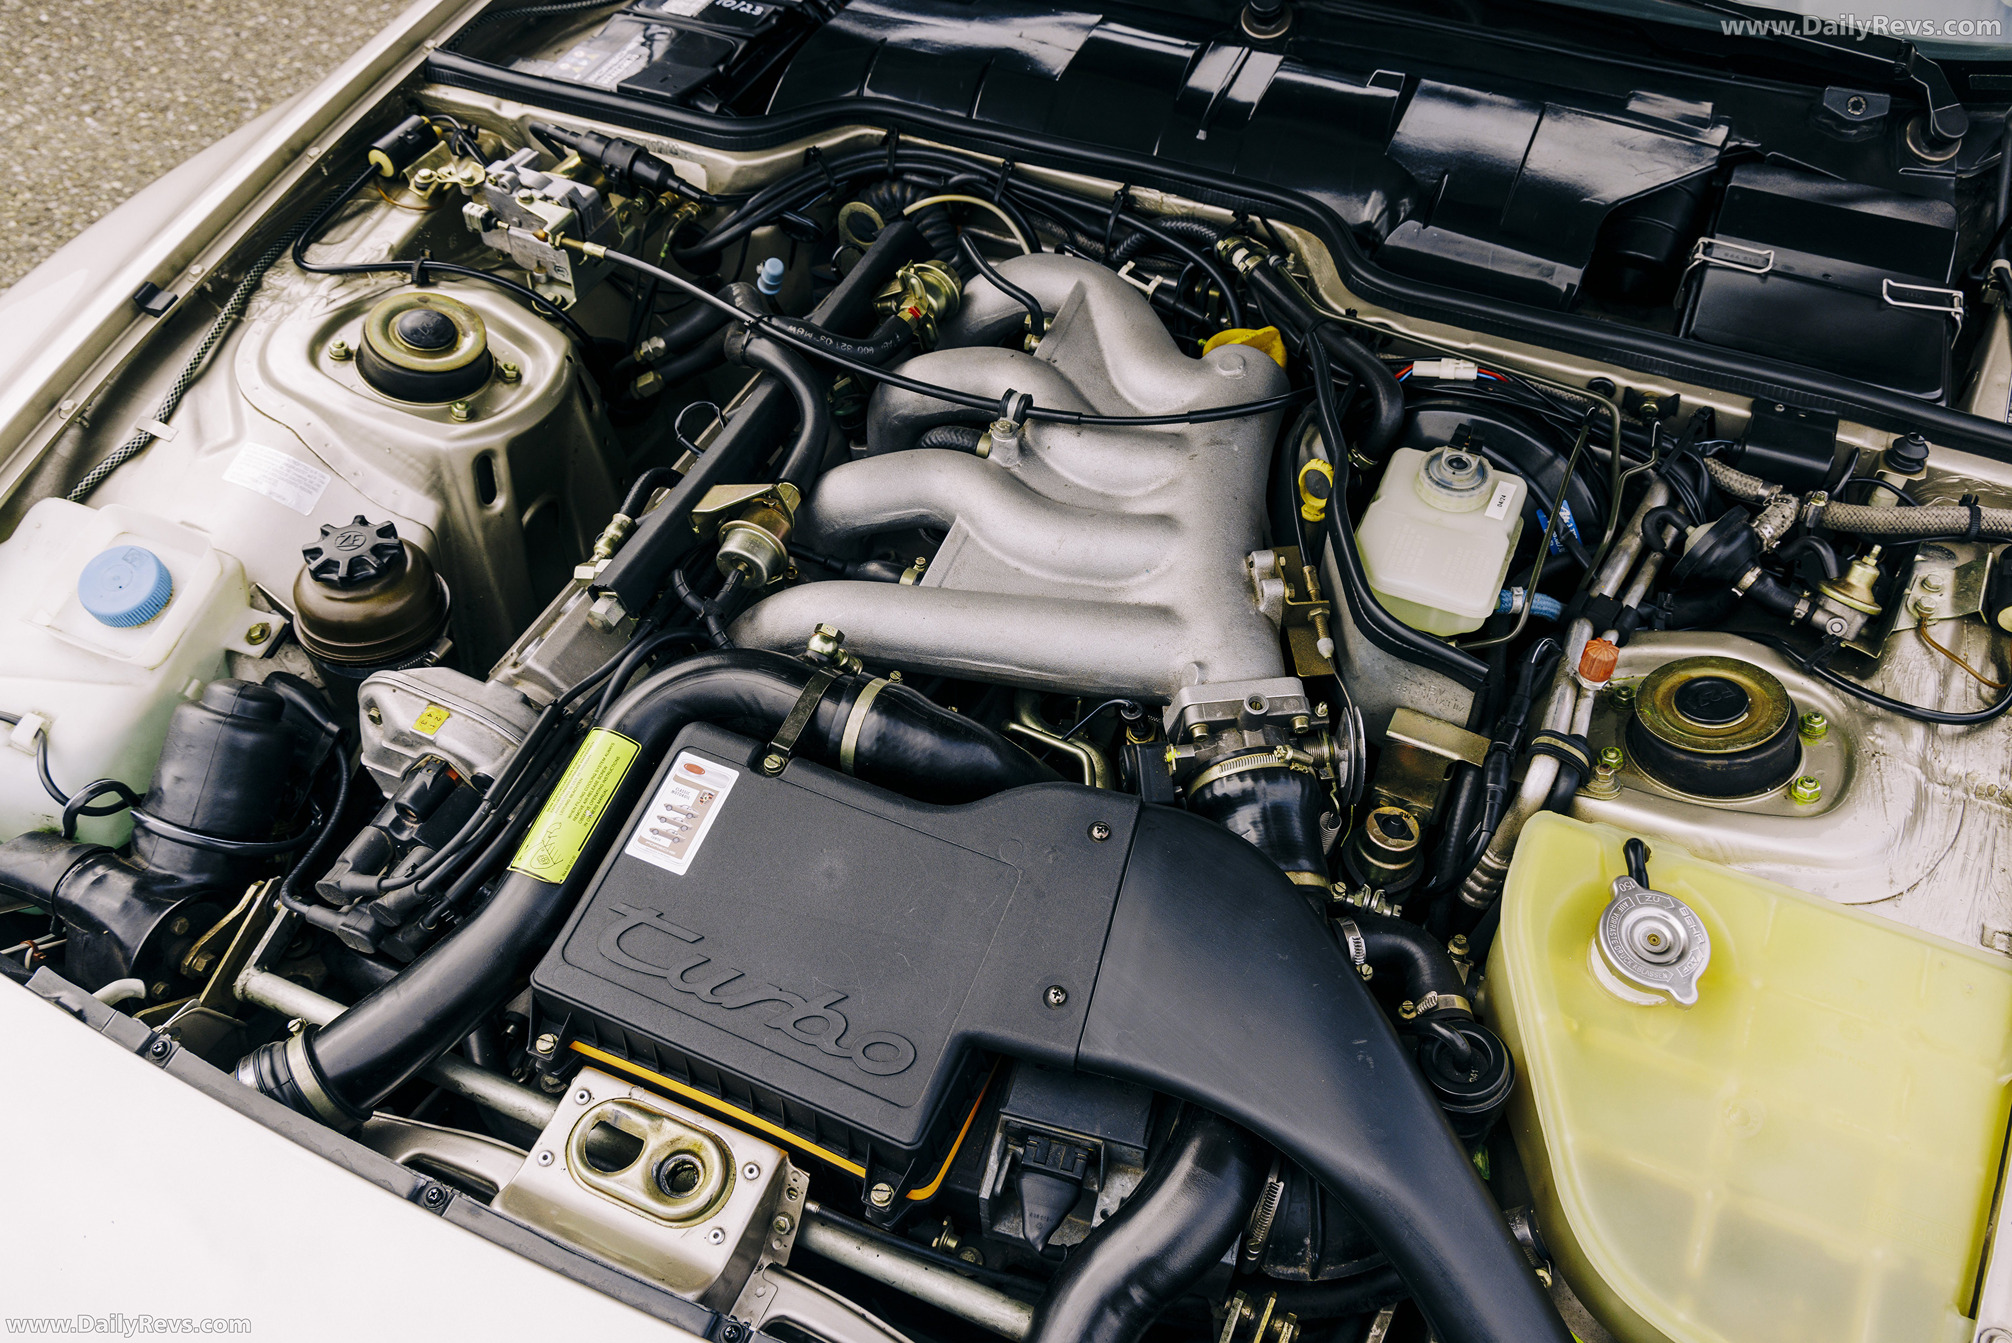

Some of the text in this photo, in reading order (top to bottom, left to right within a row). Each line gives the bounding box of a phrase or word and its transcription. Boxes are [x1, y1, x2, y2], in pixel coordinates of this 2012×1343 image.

[336, 534, 363, 547] ZF
[574, 791, 586, 806] FILLING
[583, 772, 597, 791] COOLING
[595, 756, 606, 772] SYSTEM
[603, 741, 615, 757] ALWAYS
[588, 783, 604, 805] OPERATING
[601, 755, 620, 783] INSTRUCTIONS
[572, 804, 585, 821] REMOVE
[596, 765, 607, 780] SCREW
[596, 787, 608, 804] MANUAL
[1619, 881, 1635, 892] 150
[1645, 895, 1660, 903] ZU
[1679, 907, 1705, 945] BEHR
[1615, 945, 1633, 966] DRUCK
[1632, 963, 1669, 979] ABLASSEN
[1682, 955, 1699, 974] AUF
